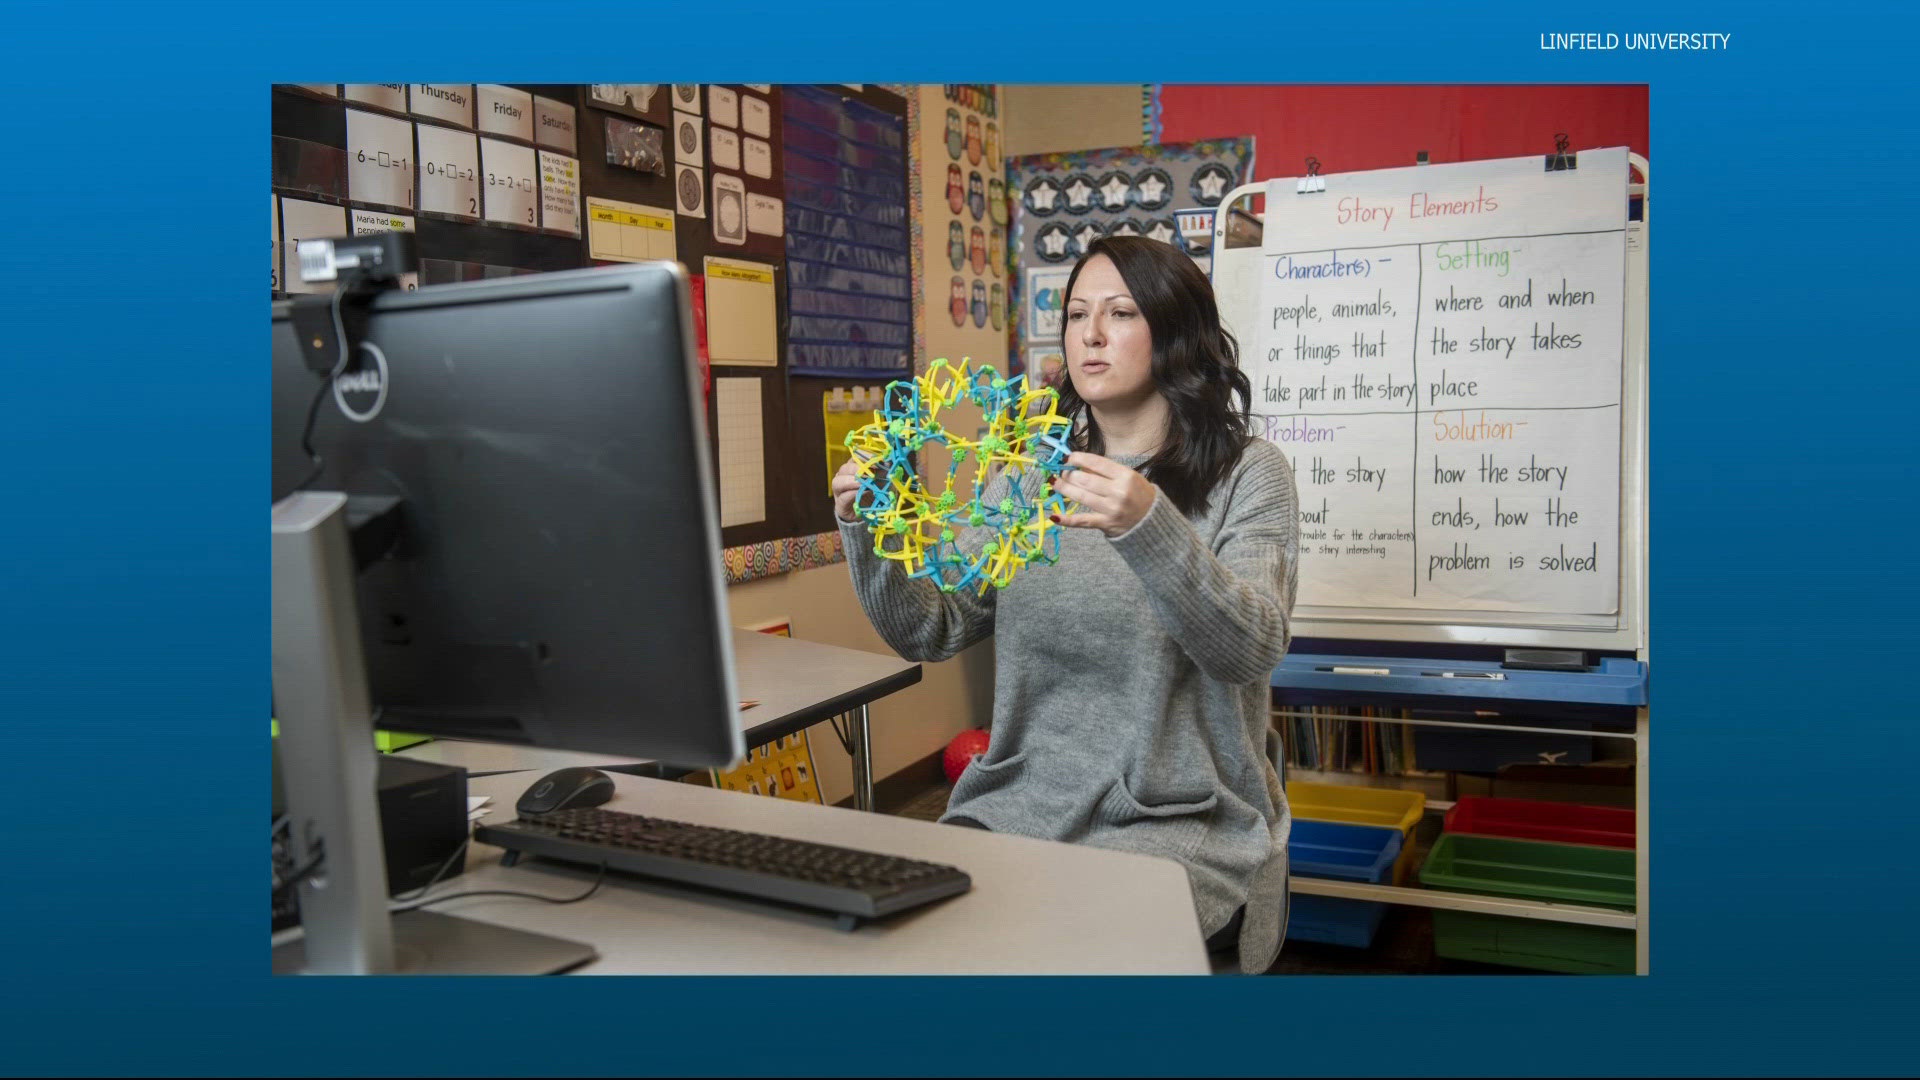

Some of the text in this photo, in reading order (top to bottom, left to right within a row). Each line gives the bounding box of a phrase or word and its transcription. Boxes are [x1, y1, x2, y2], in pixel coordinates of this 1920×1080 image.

[420, 84, 467, 108] Thursday
[493, 102, 523, 120] Friday
[356, 214, 406, 228] Maria had some
[469, 198, 477, 214] 2
[527, 207, 534, 224] 3
[1337, 185, 1499, 231] Story Elements
[1275, 249, 1371, 280] Character(s)
[1273, 288, 1397, 330] people, animals,
[1435, 277, 1595, 312] where and when
[1268, 329, 1387, 366] or things that
[1431, 322, 1583, 359] the story takes
[1262, 373, 1416, 410] take part in the story
[1430, 368, 1479, 407] place
[1310, 456, 1336, 485] the
[1346, 456, 1386, 492] story
[1434, 453, 1568, 491] how the story
[1431, 497, 1579, 531] ends, how the
[1318, 544, 1340, 558] story
[1346, 544, 1386, 559] interesting
[1333, 528, 1345, 541] for
[1351, 529, 1364, 540] the
[1428, 541, 1597, 582] problem is solved
